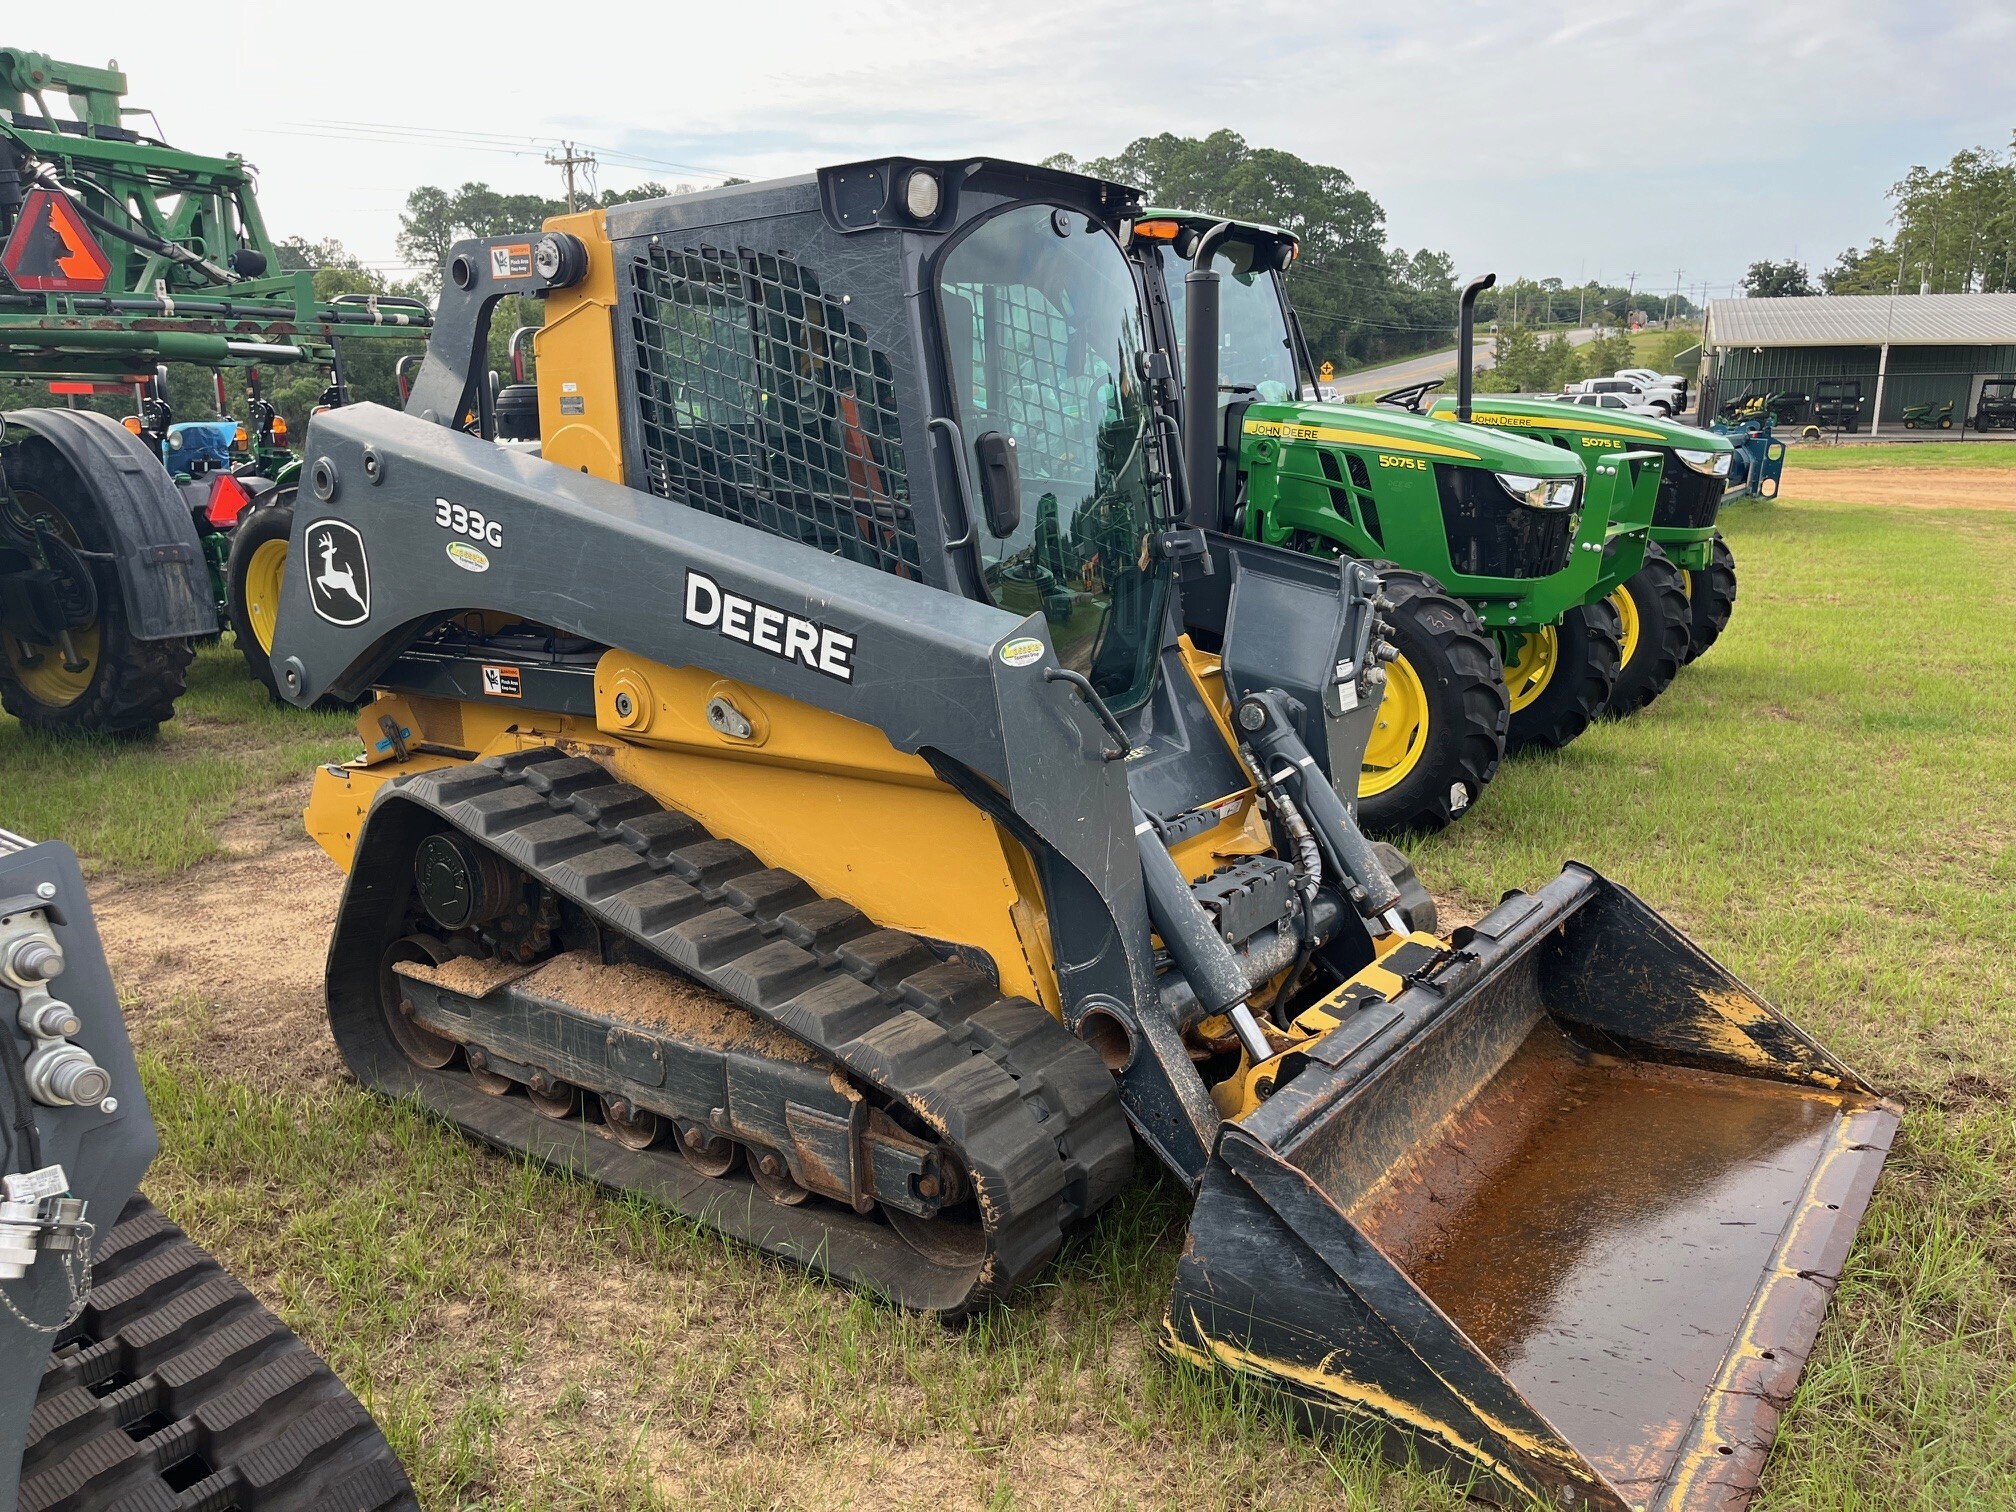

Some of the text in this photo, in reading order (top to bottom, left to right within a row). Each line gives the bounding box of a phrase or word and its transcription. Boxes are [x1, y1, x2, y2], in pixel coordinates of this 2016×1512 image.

[1472, 414, 1531, 427] JOHN DEERE
[1251, 423, 1318, 439] JOHN DEERE
[1581, 437, 1621, 449] 5075 E
[1378, 454, 1427, 471] 5075 E
[435, 497, 503, 549] 333G
[685, 570, 855, 682] DEERE
